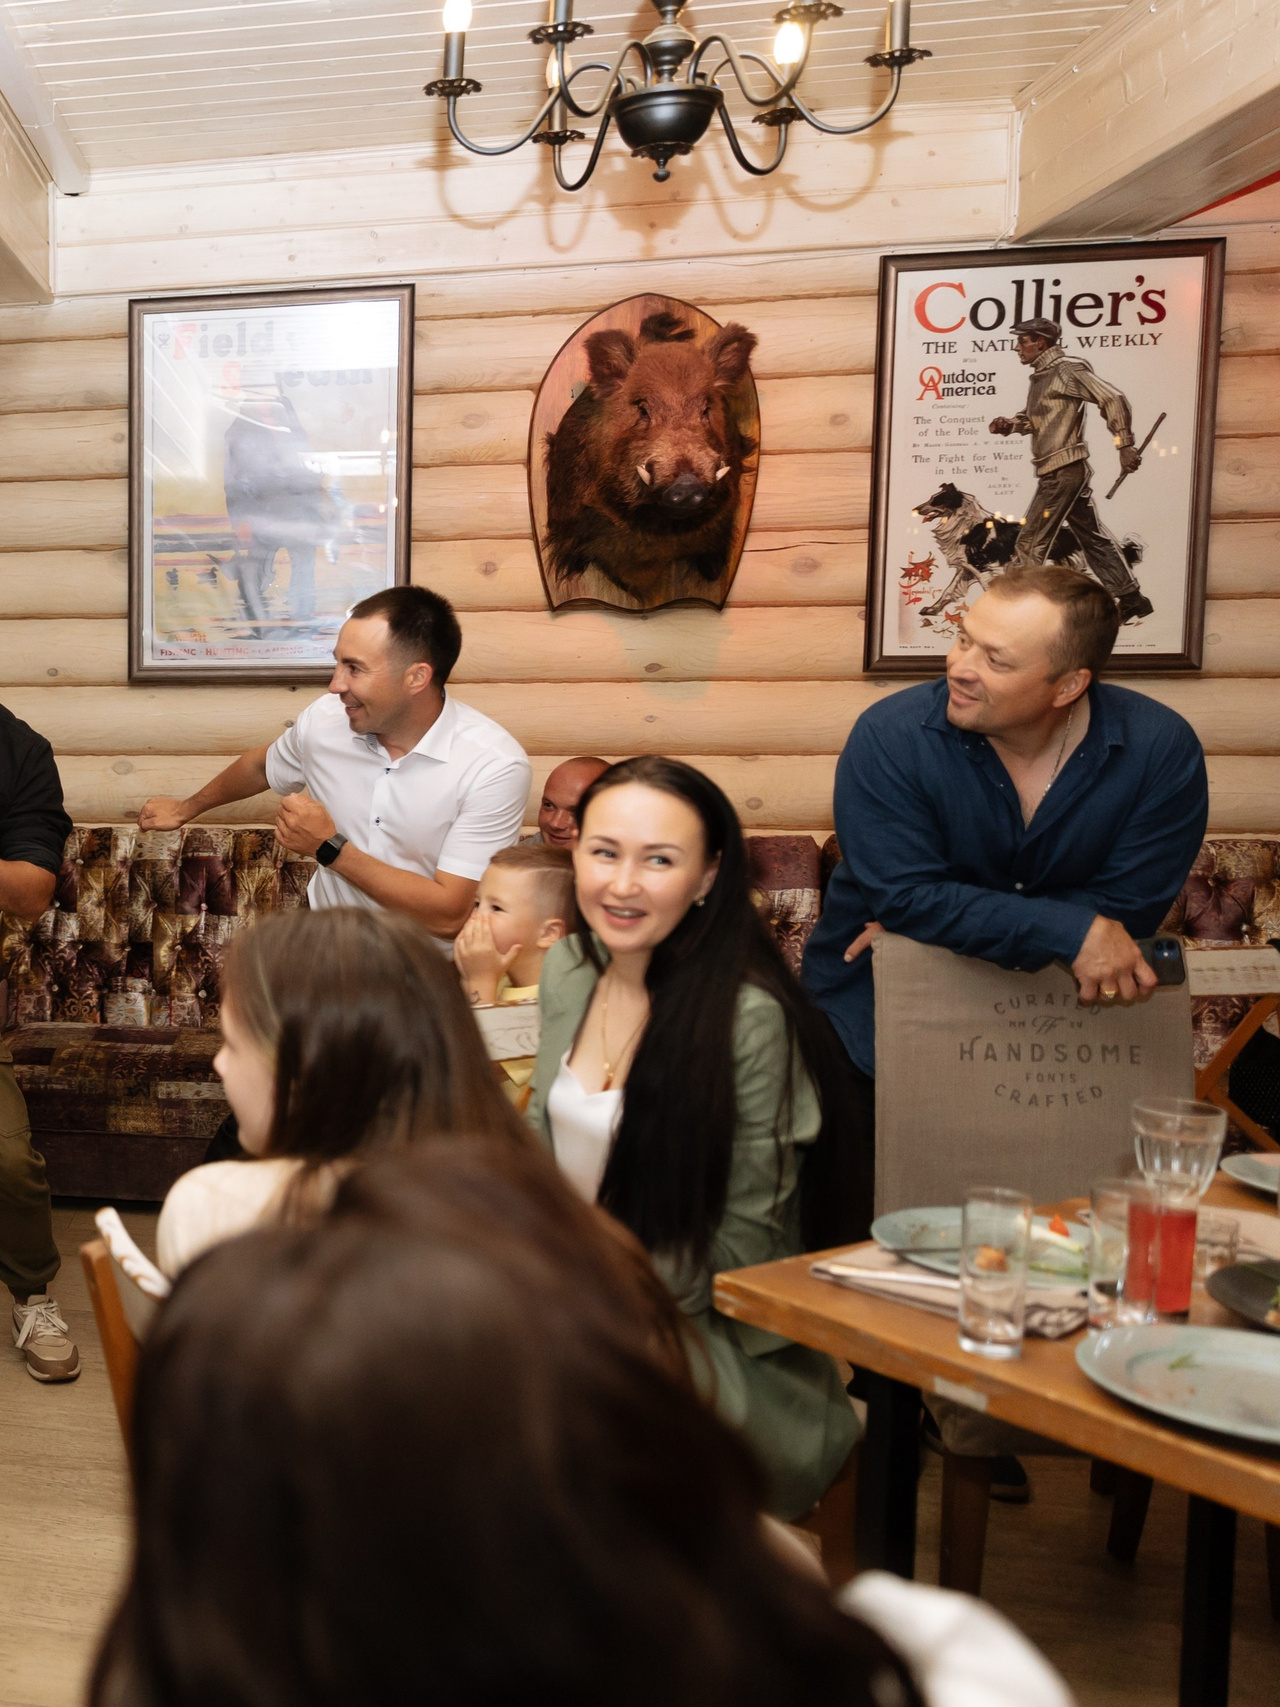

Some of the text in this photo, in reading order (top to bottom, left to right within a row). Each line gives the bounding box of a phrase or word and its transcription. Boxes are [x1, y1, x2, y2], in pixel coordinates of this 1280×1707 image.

[914, 275, 1167, 334] Collier's
[172, 320, 274, 361] Field
[922, 332, 1163, 354] THE NATIL WEEKLY
[918, 366, 997, 387] Outdoor
[915, 375, 997, 401] America
[913, 415, 985, 425] The Conquest
[918, 427, 979, 437] of the Pole
[911, 452, 1024, 463] The Fight for Water
[935, 465, 999, 475] in the West
[958, 1035, 1142, 1065] HANDSOME
[1025, 1072, 1077, 1084] FONTS
[994, 1083, 1103, 1108] CRAFTED
